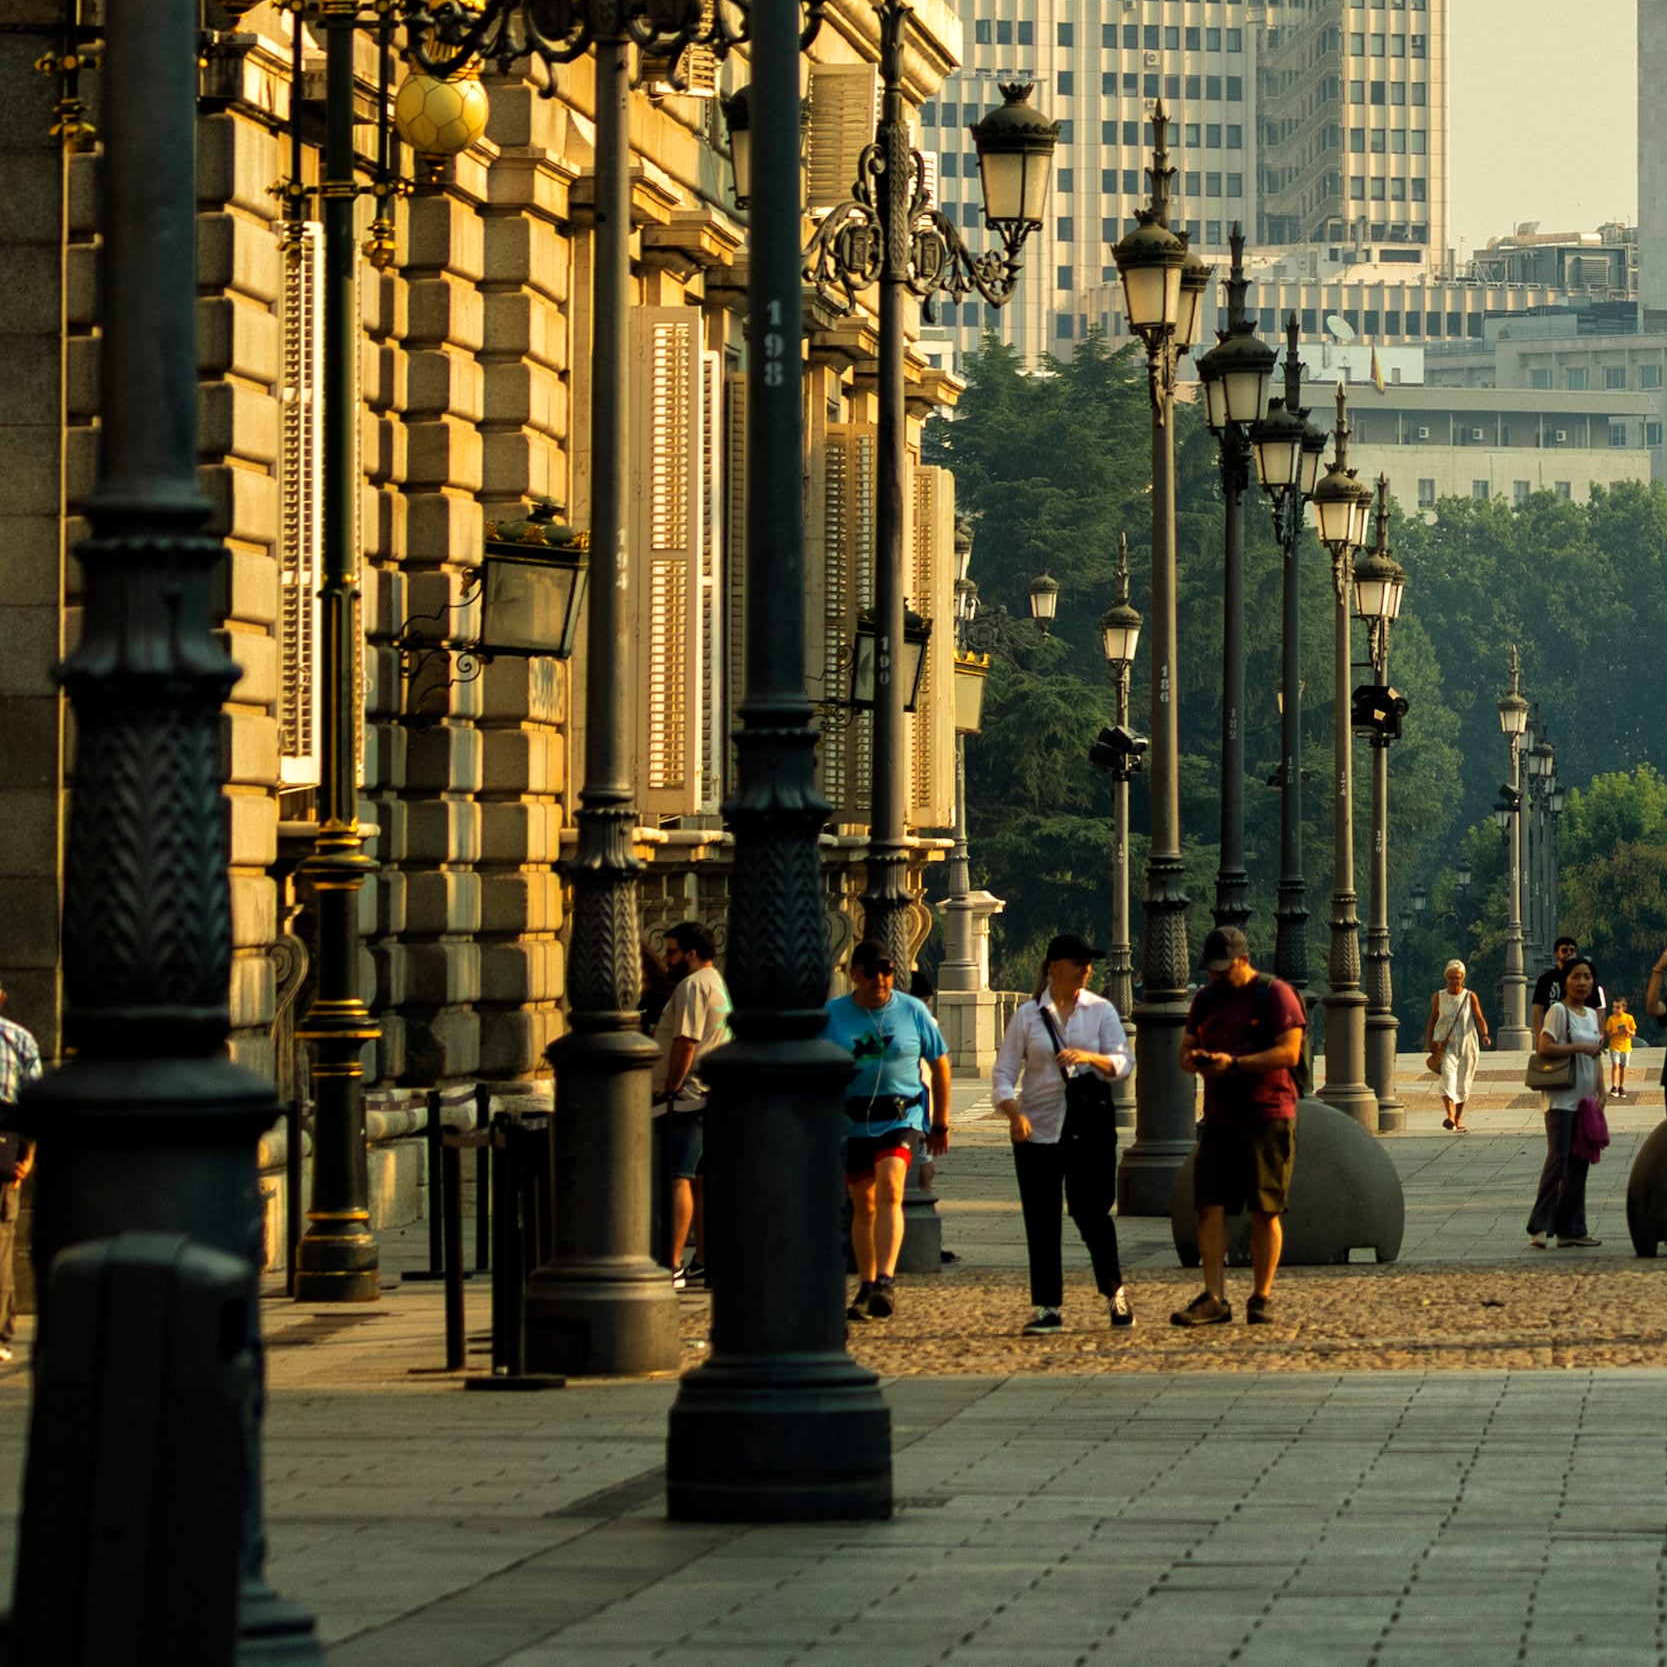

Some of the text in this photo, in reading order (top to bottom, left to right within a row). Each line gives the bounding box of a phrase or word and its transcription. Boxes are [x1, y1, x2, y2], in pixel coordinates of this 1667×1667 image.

[763, 299, 784, 386] 198
[616, 527, 629, 591] 194
[879, 636, 890, 685] 190
[1159, 665, 1170, 703] 186
[1229, 708, 1238, 740] 182
